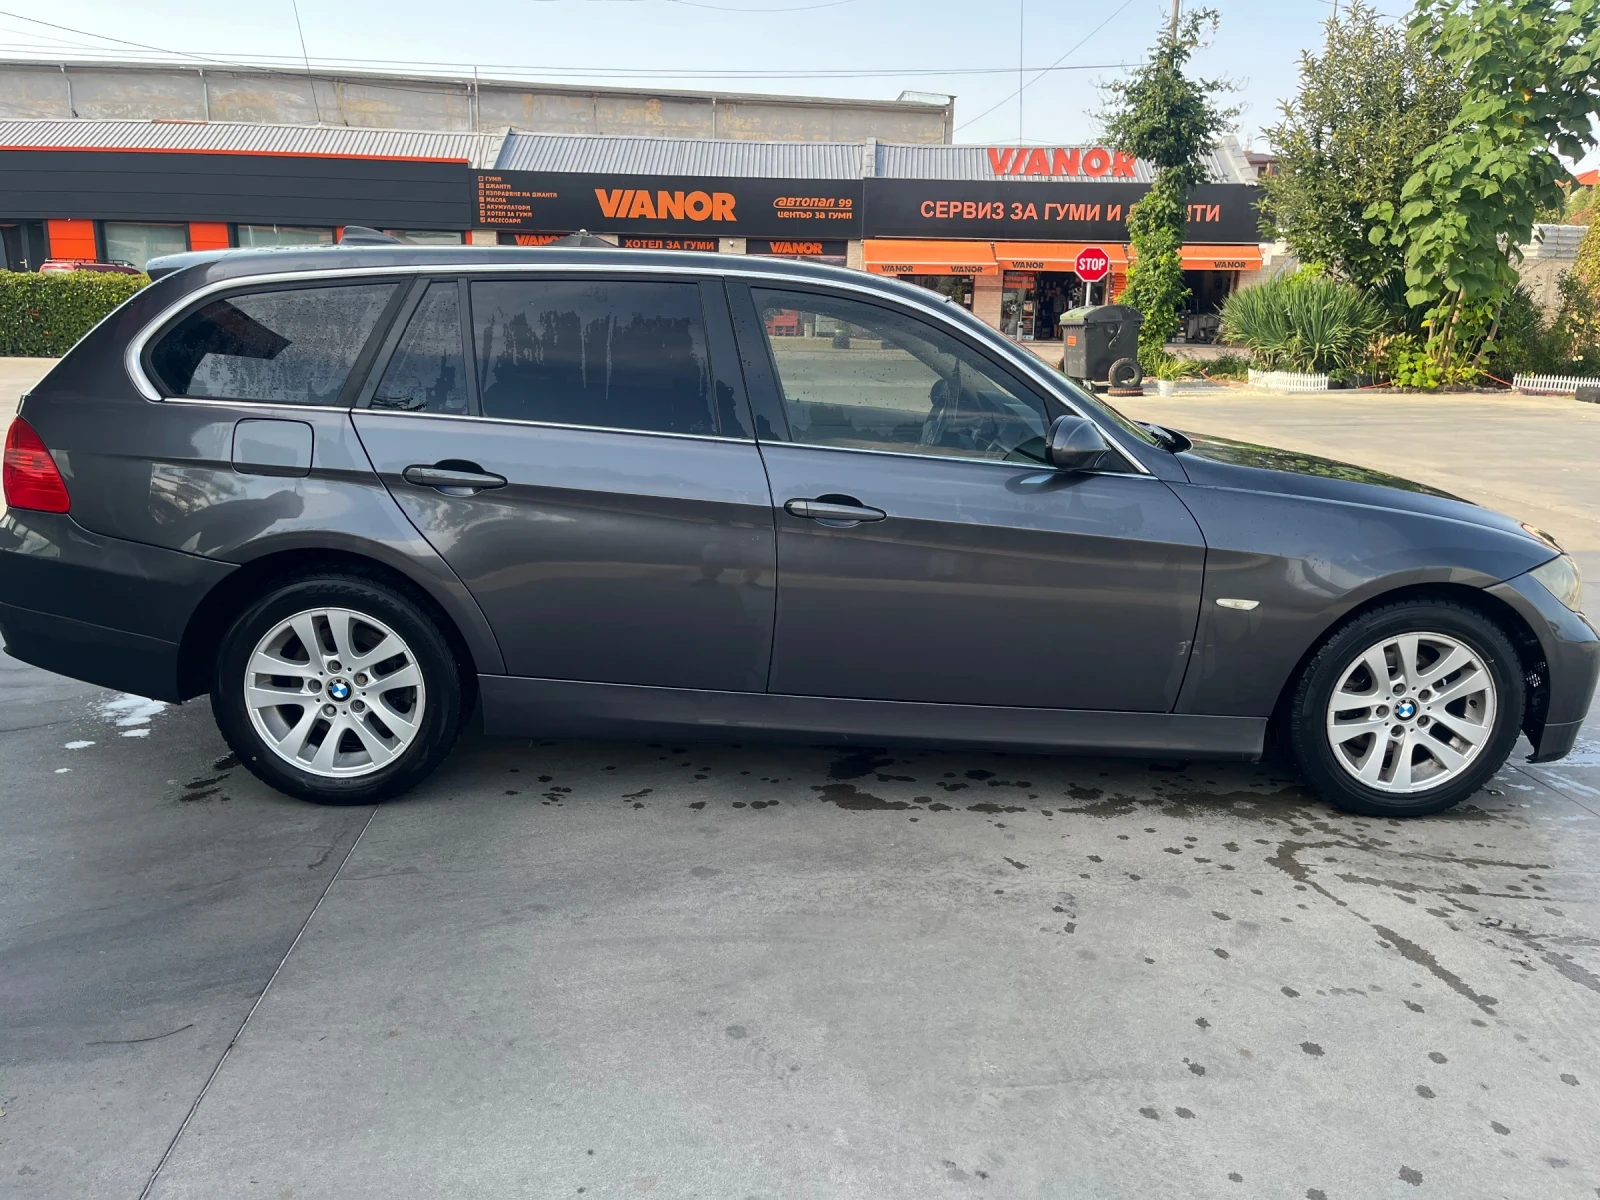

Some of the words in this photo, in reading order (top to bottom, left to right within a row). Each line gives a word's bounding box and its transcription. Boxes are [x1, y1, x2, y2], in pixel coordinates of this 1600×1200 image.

[987, 147, 1136, 177] VIANOR
[594, 188, 737, 221] VIANOR
[838, 198, 852, 208] 99
[777, 211, 813, 219] център
[815, 211, 826, 219] за
[920, 200, 1005, 220] СЕРВИЗ
[1010, 202, 1038, 220] ЗА
[1044, 203, 1101, 221] ГУМИ
[1106, 204, 1121, 221] И
[514, 234, 566, 246] VIAN
[625, 239, 663, 249] ХОТЕЛ
[666, 240, 681, 249] ЗА
[683, 241, 715, 250] ГУМИ
[769, 241, 823, 254] VIANOR
[950, 265, 982, 273] VIANOR
[1012, 261, 1044, 269] VIANOR
[1079, 257, 1106, 270] STOP
[1214, 261, 1246, 269] VIANOR
